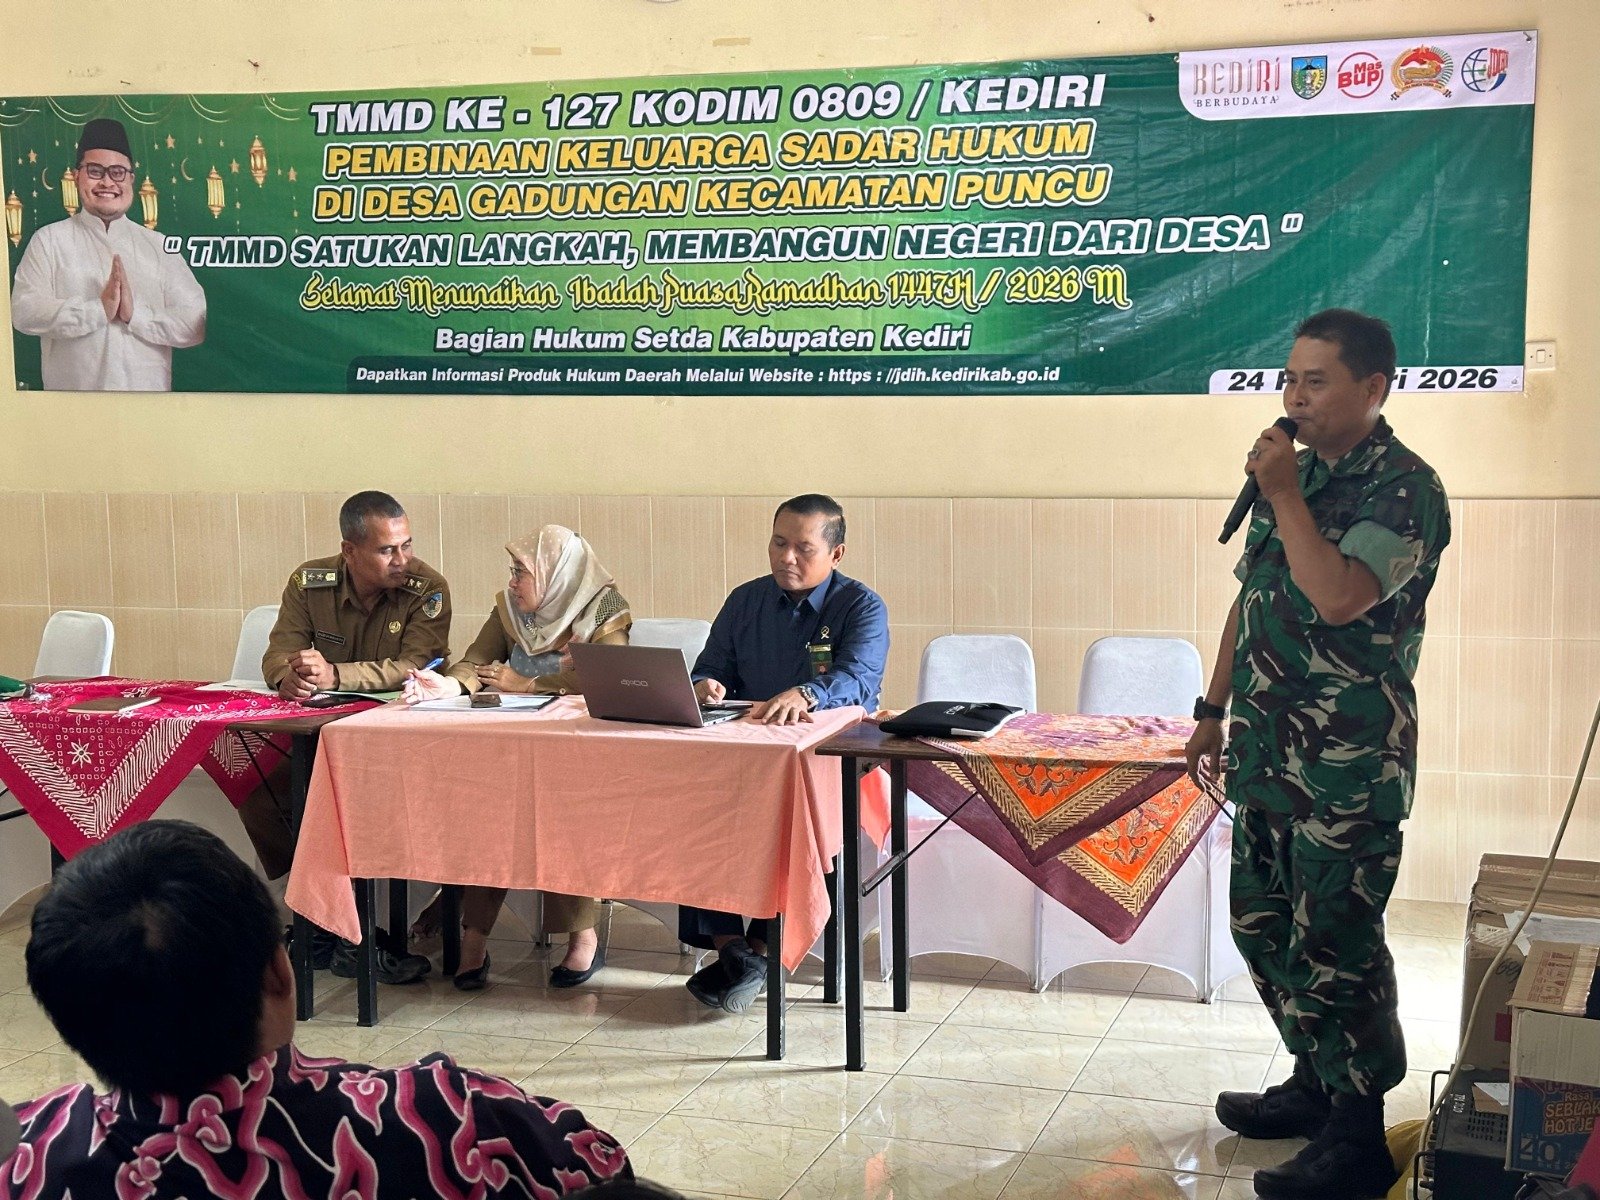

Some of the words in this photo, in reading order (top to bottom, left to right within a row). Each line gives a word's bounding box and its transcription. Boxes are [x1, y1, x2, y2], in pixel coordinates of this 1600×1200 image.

[1354, 61, 1382, 73] Mas
[310, 101, 434, 135] TMMD
[445, 98, 503, 130] KE
[544, 92, 619, 129] 127
[632, 87, 779, 126] KODIM
[792, 83, 904, 121] 0809
[908, 83, 932, 120] /
[939, 74, 1106, 115] KEDIRI
[1195, 96, 1278, 107] BERBUDAYA
[326, 140, 550, 177] PEMBINAAN
[557, 132, 772, 172] KELUARGA
[780, 125, 921, 167] SADAR
[929, 118, 1097, 160] HUKUM
[314, 185, 358, 221] DI
[364, 183, 462, 219] DESA
[469, 178, 690, 217] GADUNGAN
[697, 170, 948, 212] KECAMATAN
[952, 163, 1113, 205] PUNCU
[188, 236, 286, 268] TMMD
[291, 233, 451, 268] SATUKAN
[456, 229, 639, 269] LANGKAH,
[645, 223, 892, 262] MEMBANGUN
[896, 219, 1047, 259] NEGERI
[1048, 217, 1153, 255] DARI
[1156, 214, 1271, 253] DESA
[299, 270, 401, 312] Selamat
[401, 274, 562, 316] Menunaikan
[569, 274, 662, 309] Ibadah
[658, 268, 742, 317] Puasa
[740, 266, 886, 316] Ramadhan
[979, 269, 1004, 305] /
[1005, 267, 1079, 301] 2026
[1084, 269, 1134, 309] M
[434, 327, 525, 354] Bagian
[531, 325, 626, 351] Hukum
[634, 324, 713, 350] Setda
[720, 323, 877, 356] Kabupaten
[882, 323, 973, 351] Kediri
[355, 367, 427, 385] Dapatkan
[431, 366, 503, 382] Informasi
[507, 366, 562, 382] Produk
[566, 367, 622, 382] Hukum
[625, 367, 682, 382] Daerah
[686, 366, 745, 382] Melalui
[749, 367, 814, 382] Website
[828, 367, 872, 385] https
[884, 366, 1060, 386] //jdih.kedirikab.go.id
[1227, 371, 1265, 391] 24
[1417, 368, 1499, 389] 2026
[1545, 1100, 1600, 1118] SEBLAK
[1544, 1118, 1575, 1134] HOT
